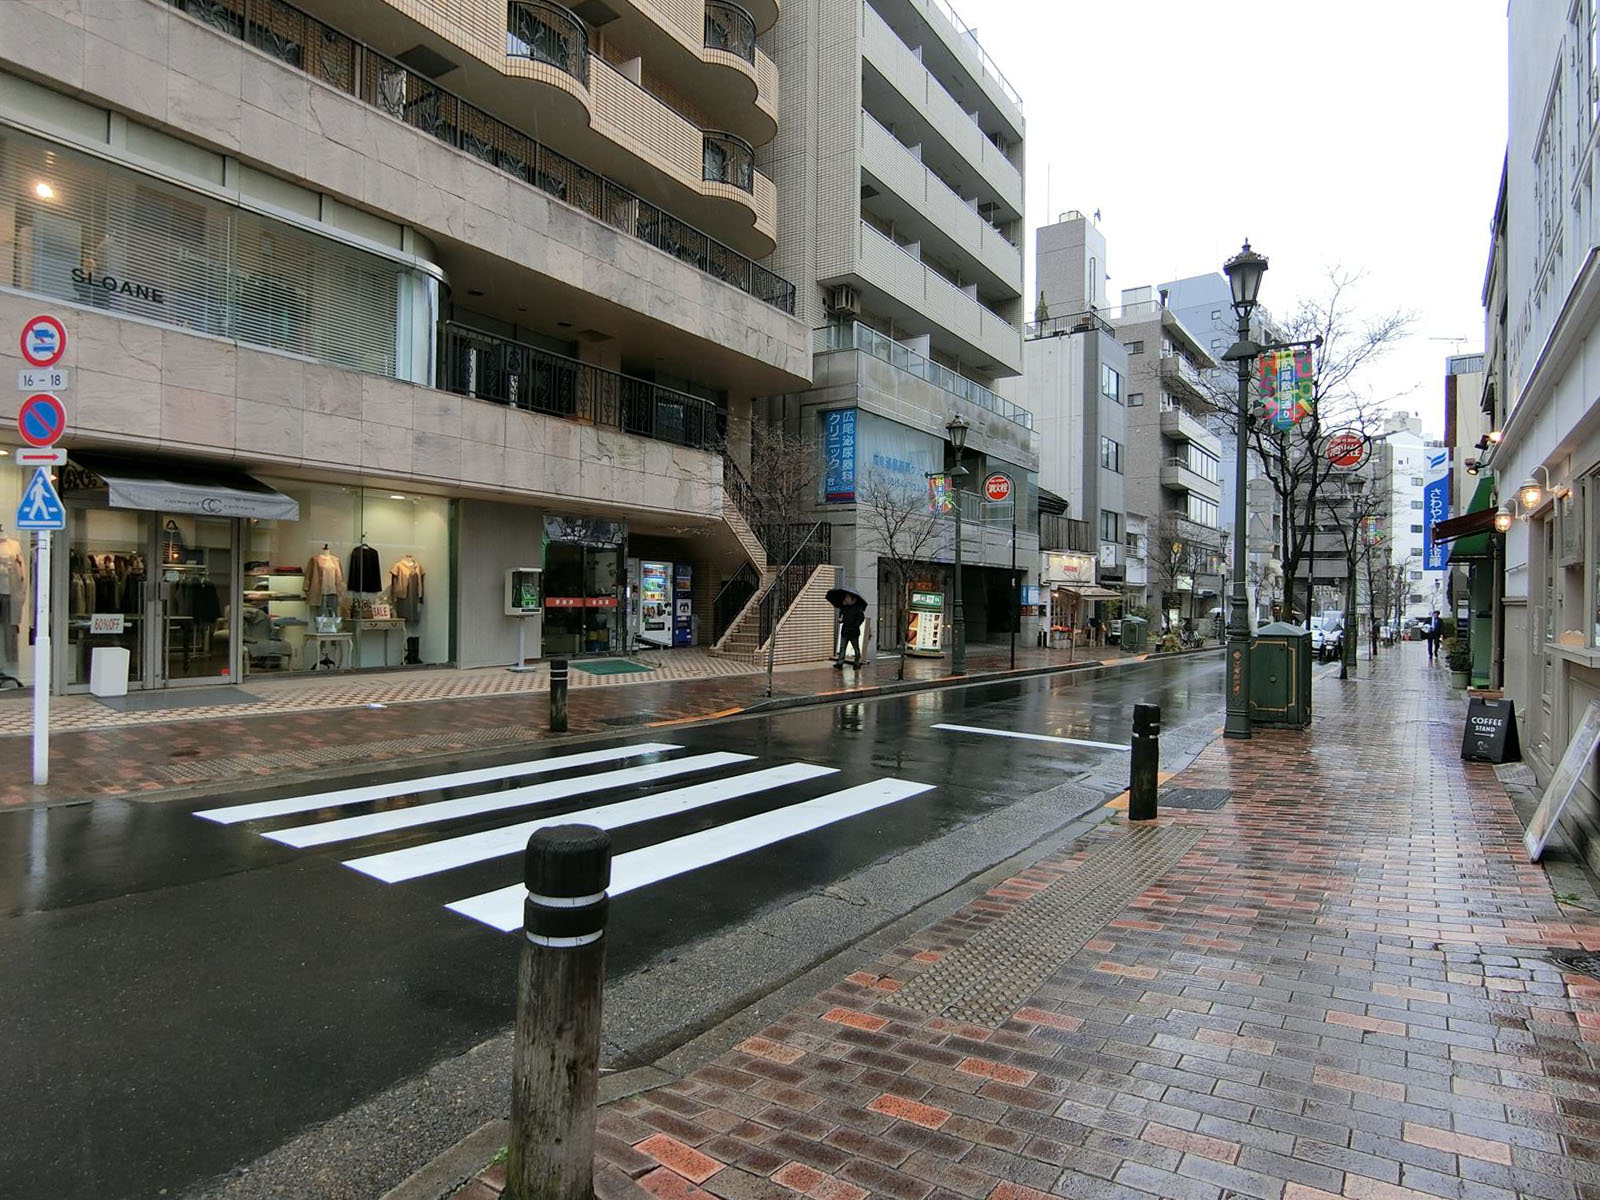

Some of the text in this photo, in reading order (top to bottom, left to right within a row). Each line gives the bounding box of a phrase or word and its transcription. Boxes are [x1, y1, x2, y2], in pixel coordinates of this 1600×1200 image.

[71, 268, 164, 304] SLOANE
[23, 374, 34, 387] 16
[50, 373, 61, 387] 18
[828, 413, 840, 469] クリニック
[1471, 716, 1503, 727] COFFEE
[1475, 725, 1496, 733] STAND
